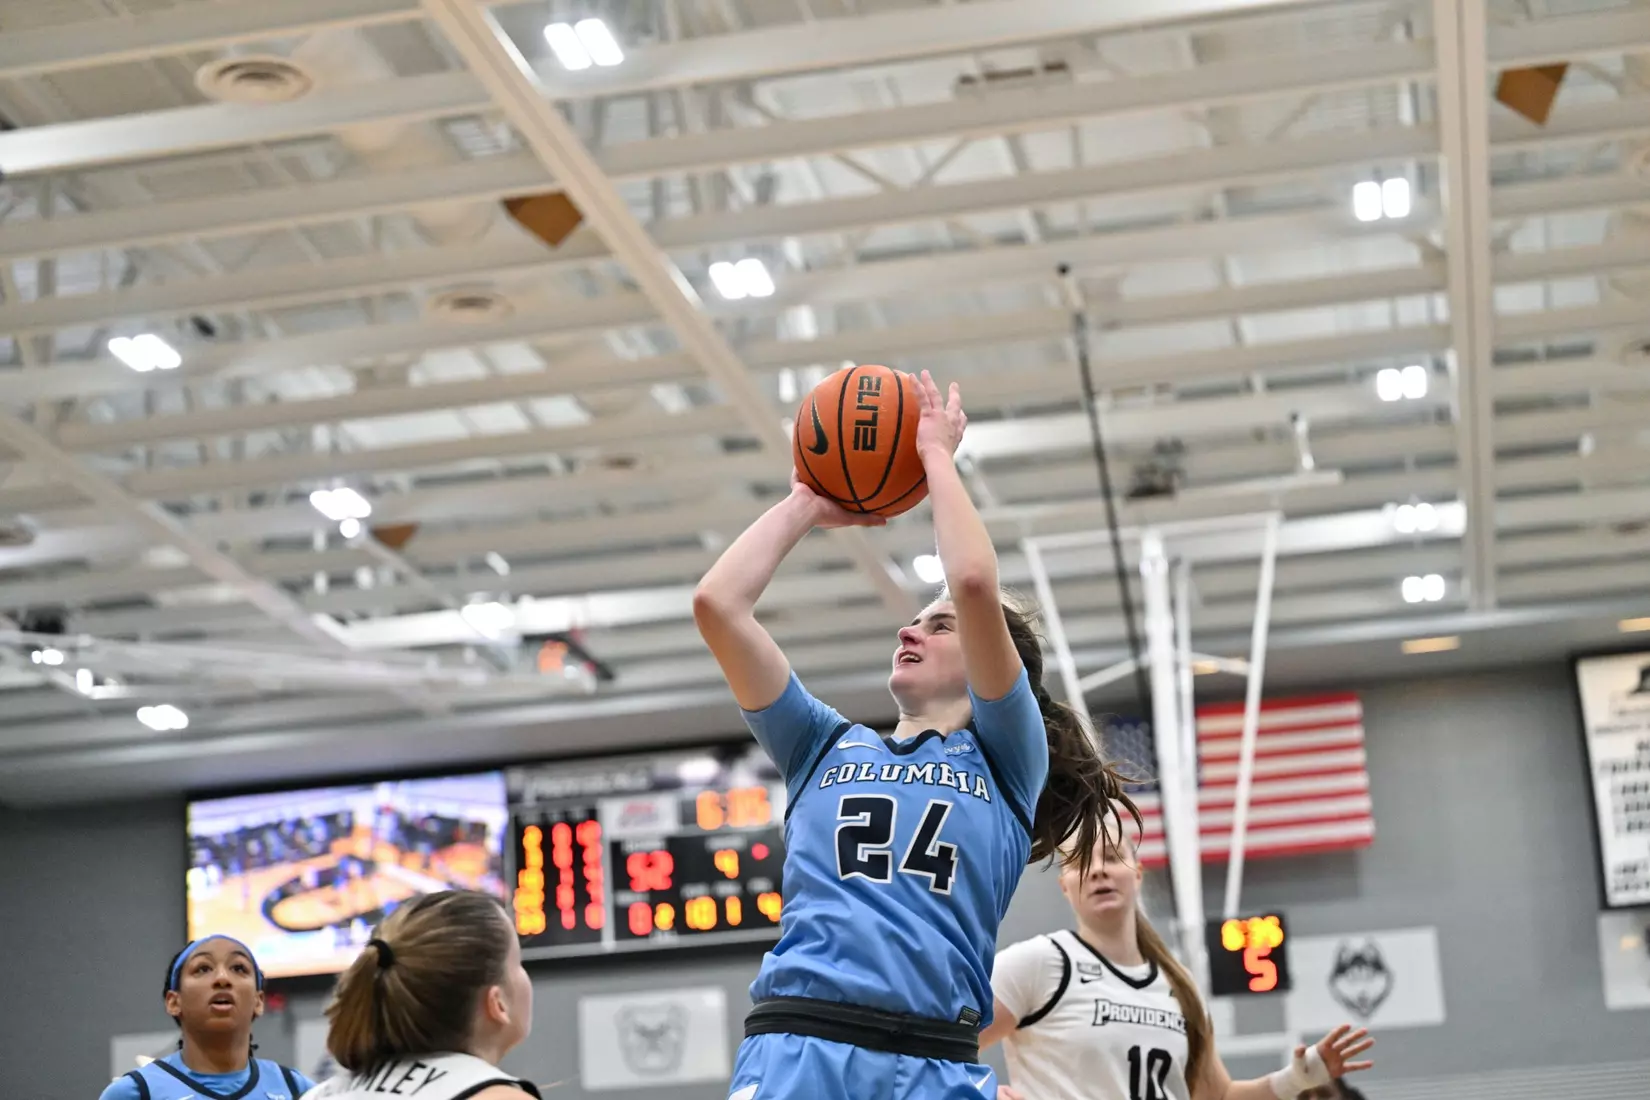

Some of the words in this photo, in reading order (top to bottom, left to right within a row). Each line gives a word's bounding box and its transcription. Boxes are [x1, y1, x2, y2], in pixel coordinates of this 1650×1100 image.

[853, 375, 882, 451] ELITE
[818, 762, 992, 803] COLUMBIA
[834, 793, 959, 895] 24
[1243, 944, 1278, 992] 5
[1127, 1045, 1173, 1100] 10
